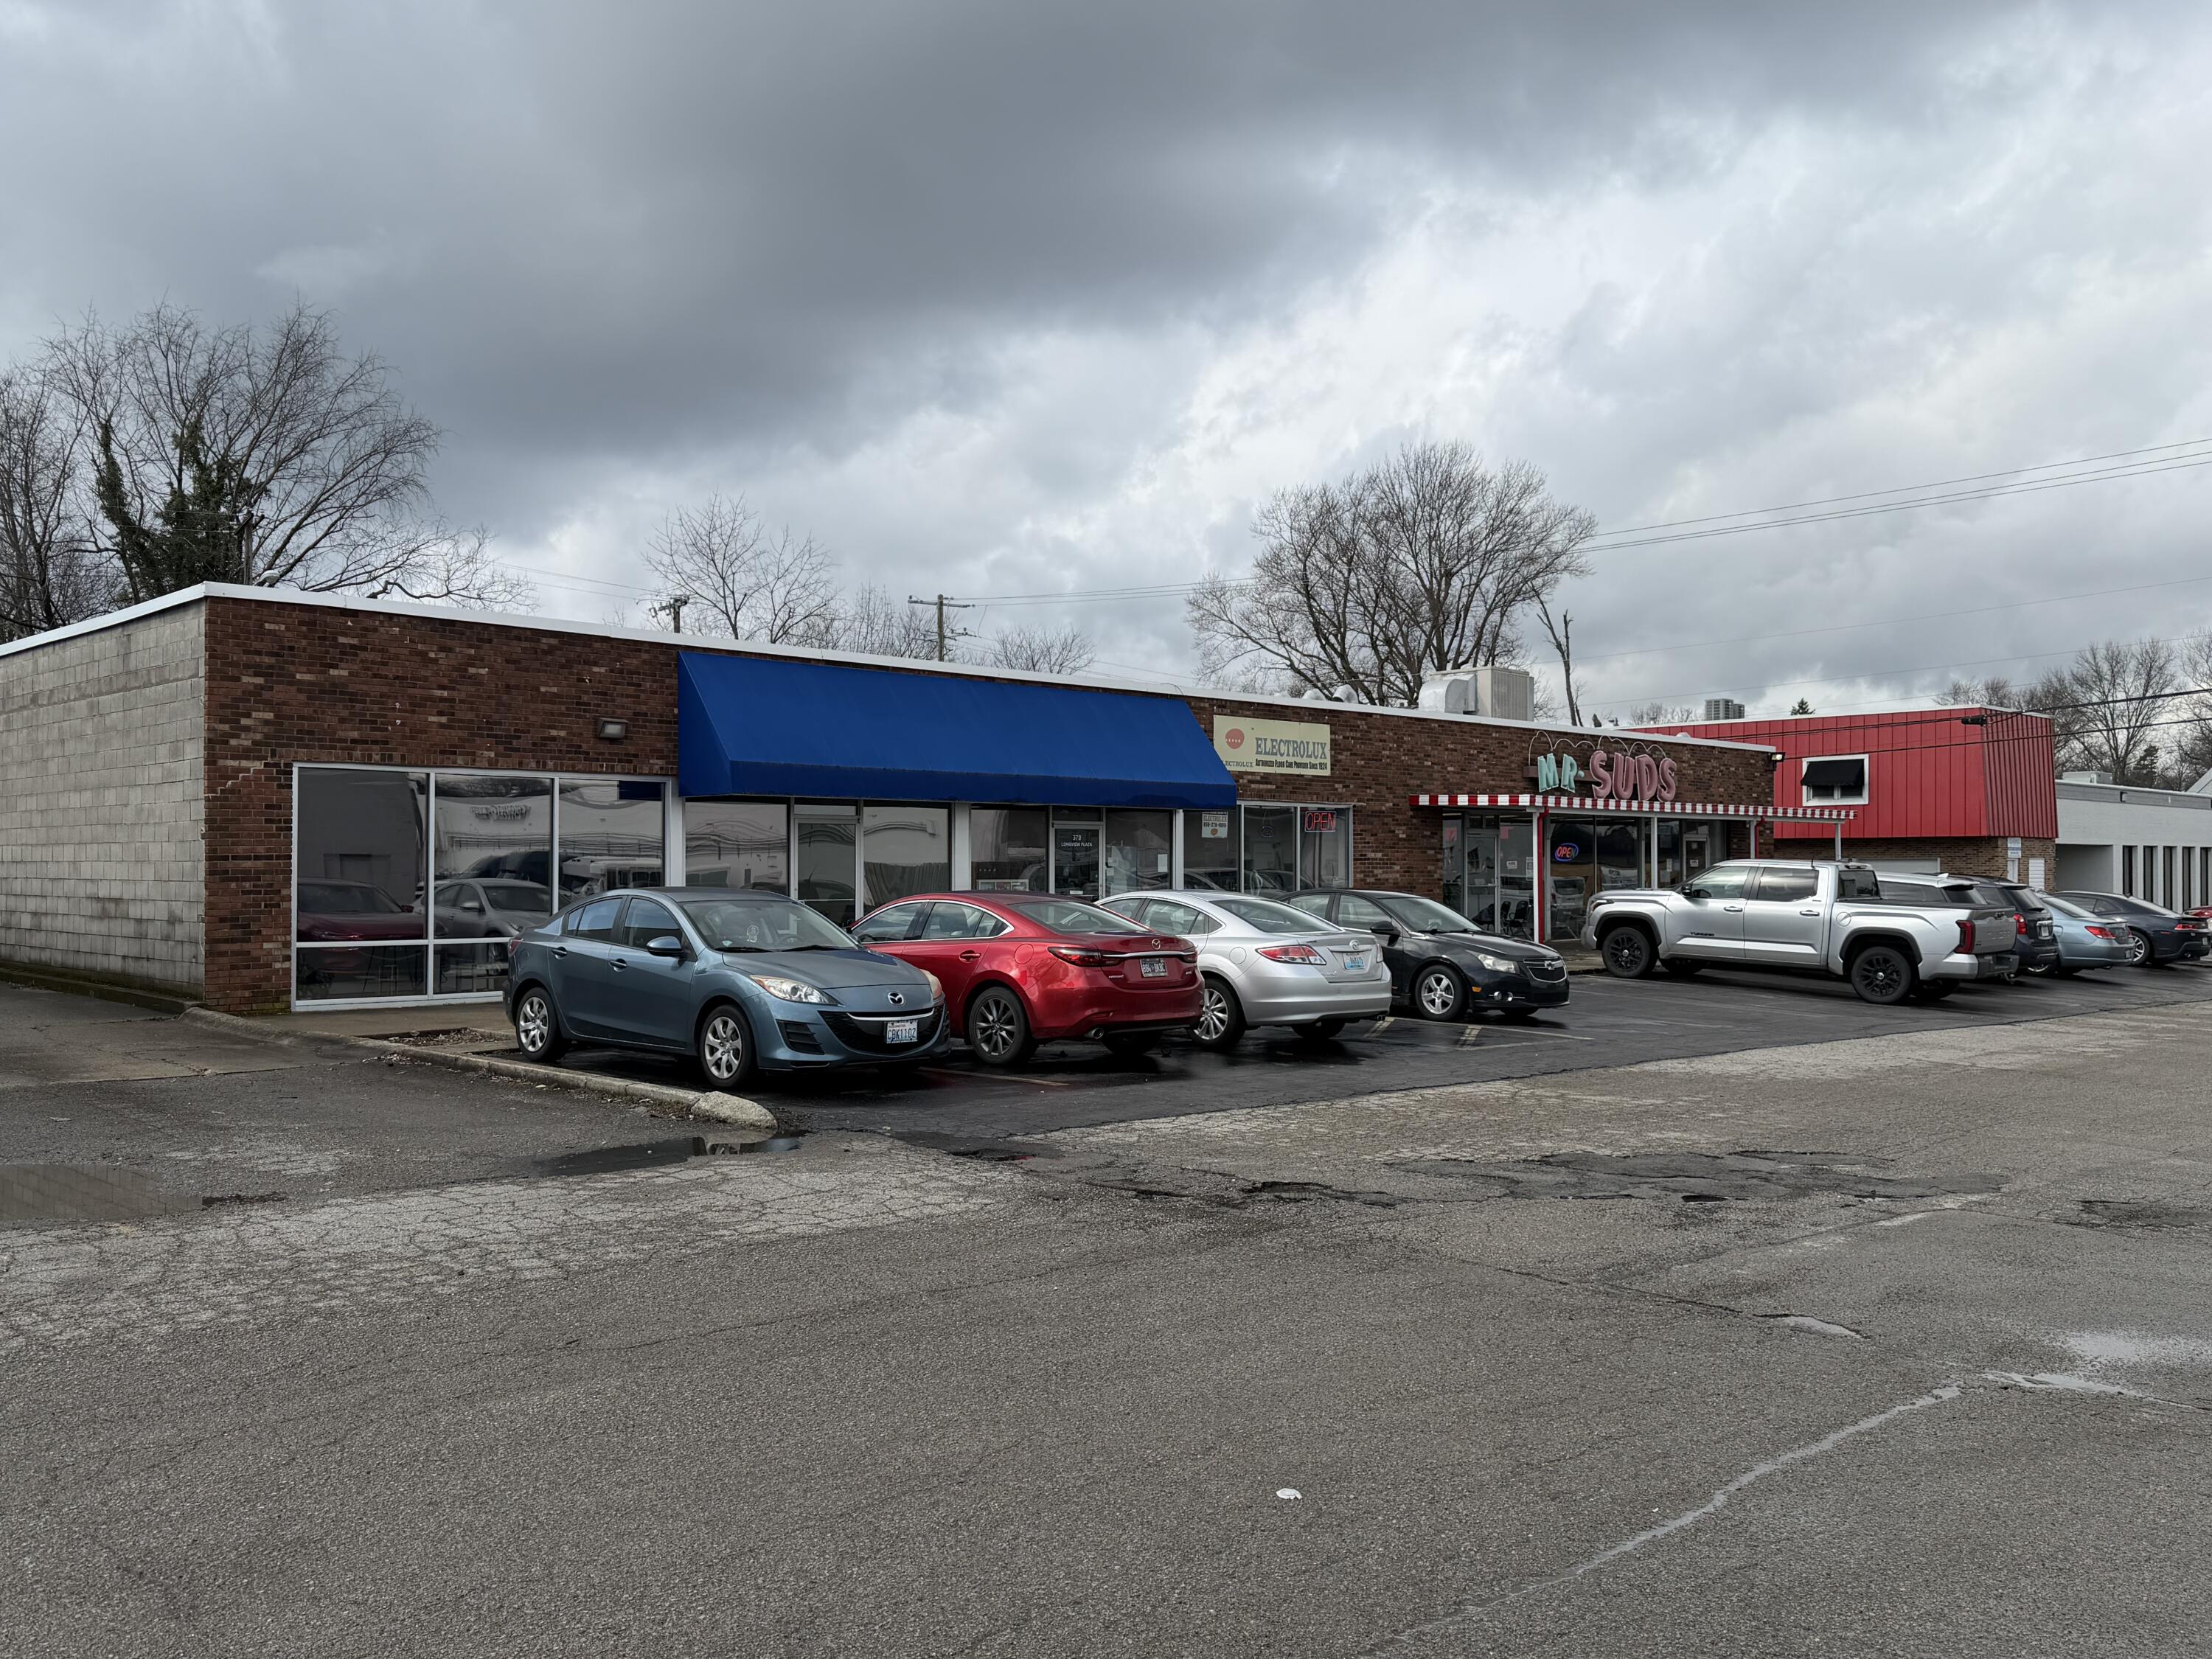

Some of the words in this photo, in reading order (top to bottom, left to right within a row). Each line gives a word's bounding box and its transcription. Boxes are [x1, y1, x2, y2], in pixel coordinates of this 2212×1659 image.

[1255, 737, 1327, 759] ELECTROLUX
[1590, 751, 1677, 802] SUDS
[1307, 813, 1335, 830] OPEN
[1557, 846, 1576, 859] OPEN
